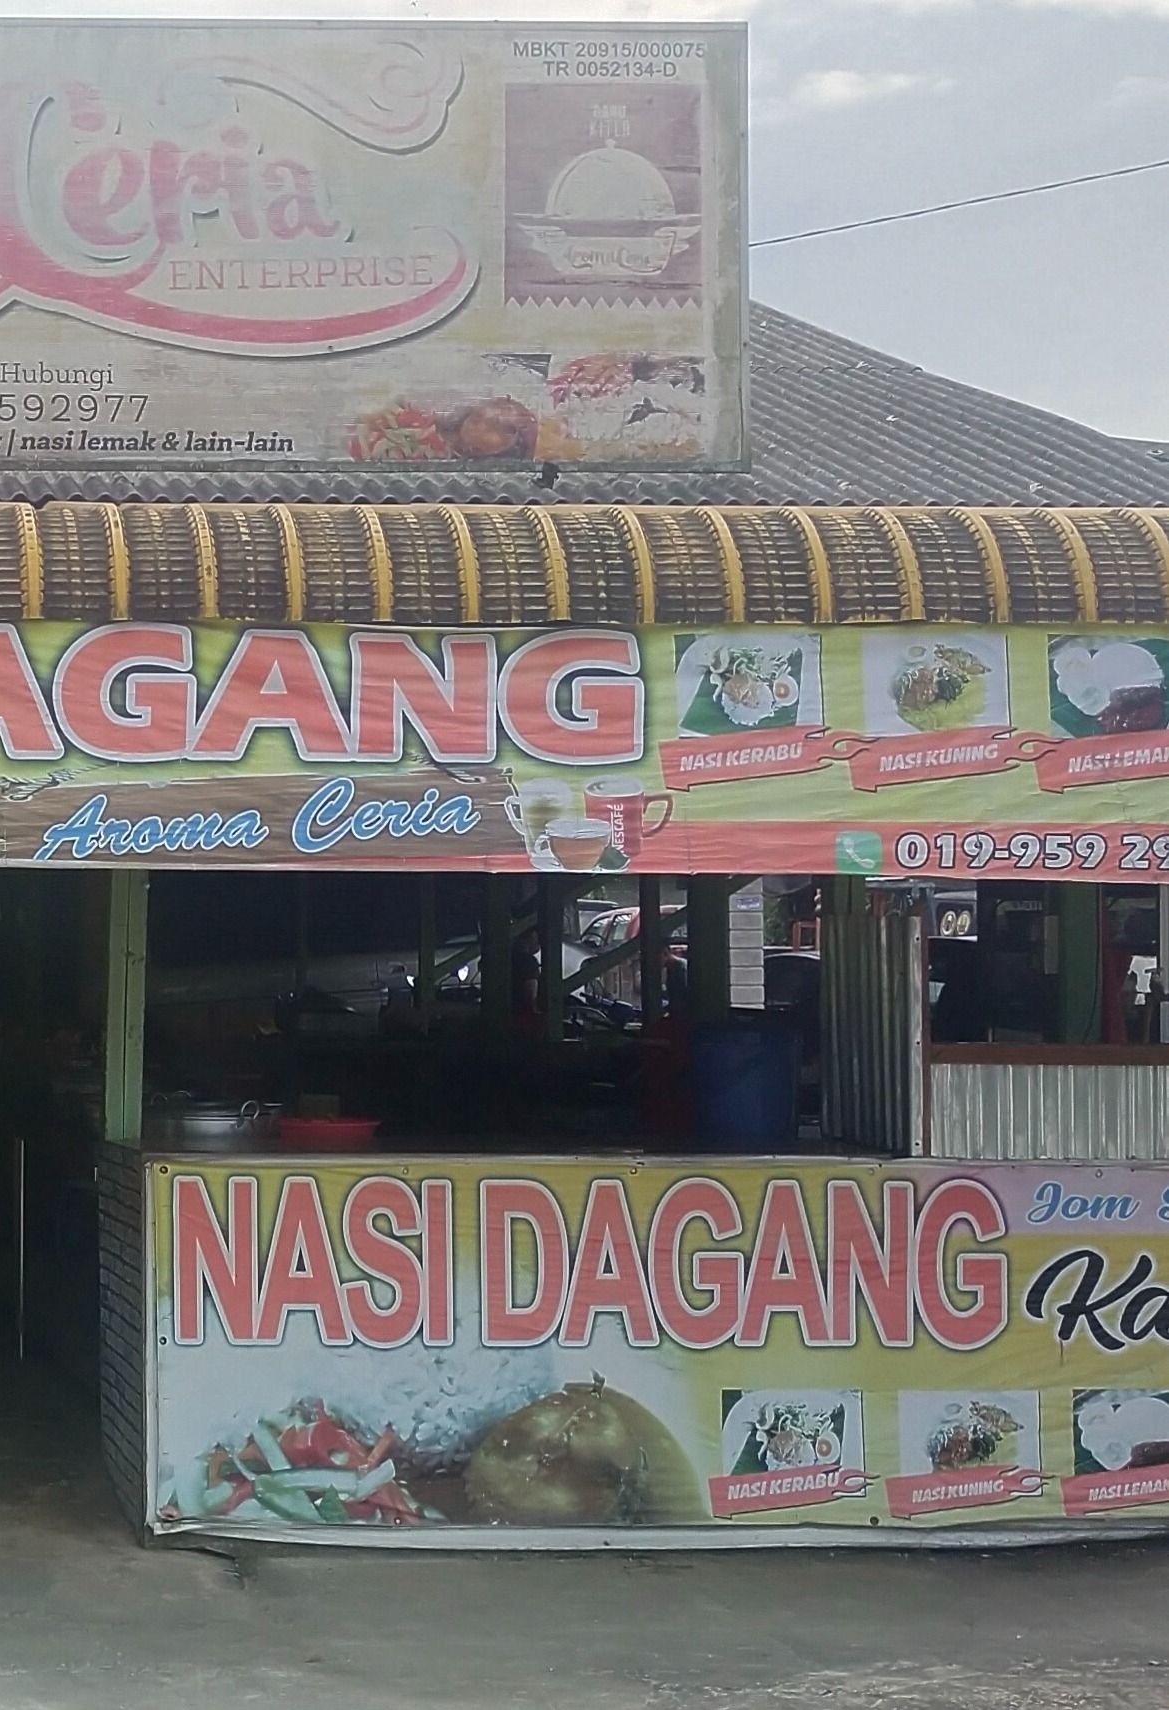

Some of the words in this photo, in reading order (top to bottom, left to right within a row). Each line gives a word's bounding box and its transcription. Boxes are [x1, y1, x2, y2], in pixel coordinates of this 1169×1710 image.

[513, 42, 569, 57] MBKT
[575, 42, 705, 58] 20915/000075
[543, 61, 569, 76] TR
[576, 61, 677, 77] 0052134-D
[168, 254, 436, 291] ENTERPRISE
[0, 361, 113, 391] Hubungi
[20, 431, 75, 451] nasi
[79, 430, 157, 451] lemak
[161, 432, 180, 451] &
[184, 431, 295, 452] lain-lain
[680, 751, 723, 771] NASI
[725, 742, 803, 767] KERABU
[879, 751, 923, 772] NASI
[925, 743, 999, 767] KUNING
[1068, 752, 1111, 773] NASI
[32, 794, 270, 862] Aroma
[291, 775, 481, 855] Ceria
[895, 830, 1109, 870] 019-959
[1027, 1181, 1140, 1224] Jom
[172, 1176, 456, 1349] NASI
[477, 1177, 1008, 1352] DAGANG
[727, 1482, 766, 1500] NASI
[769, 1472, 840, 1495] KERABU
[912, 1486, 945, 1503] NASI
[947, 1479, 1004, 1500] KUNING
[1088, 1483, 1122, 1501] NASI
